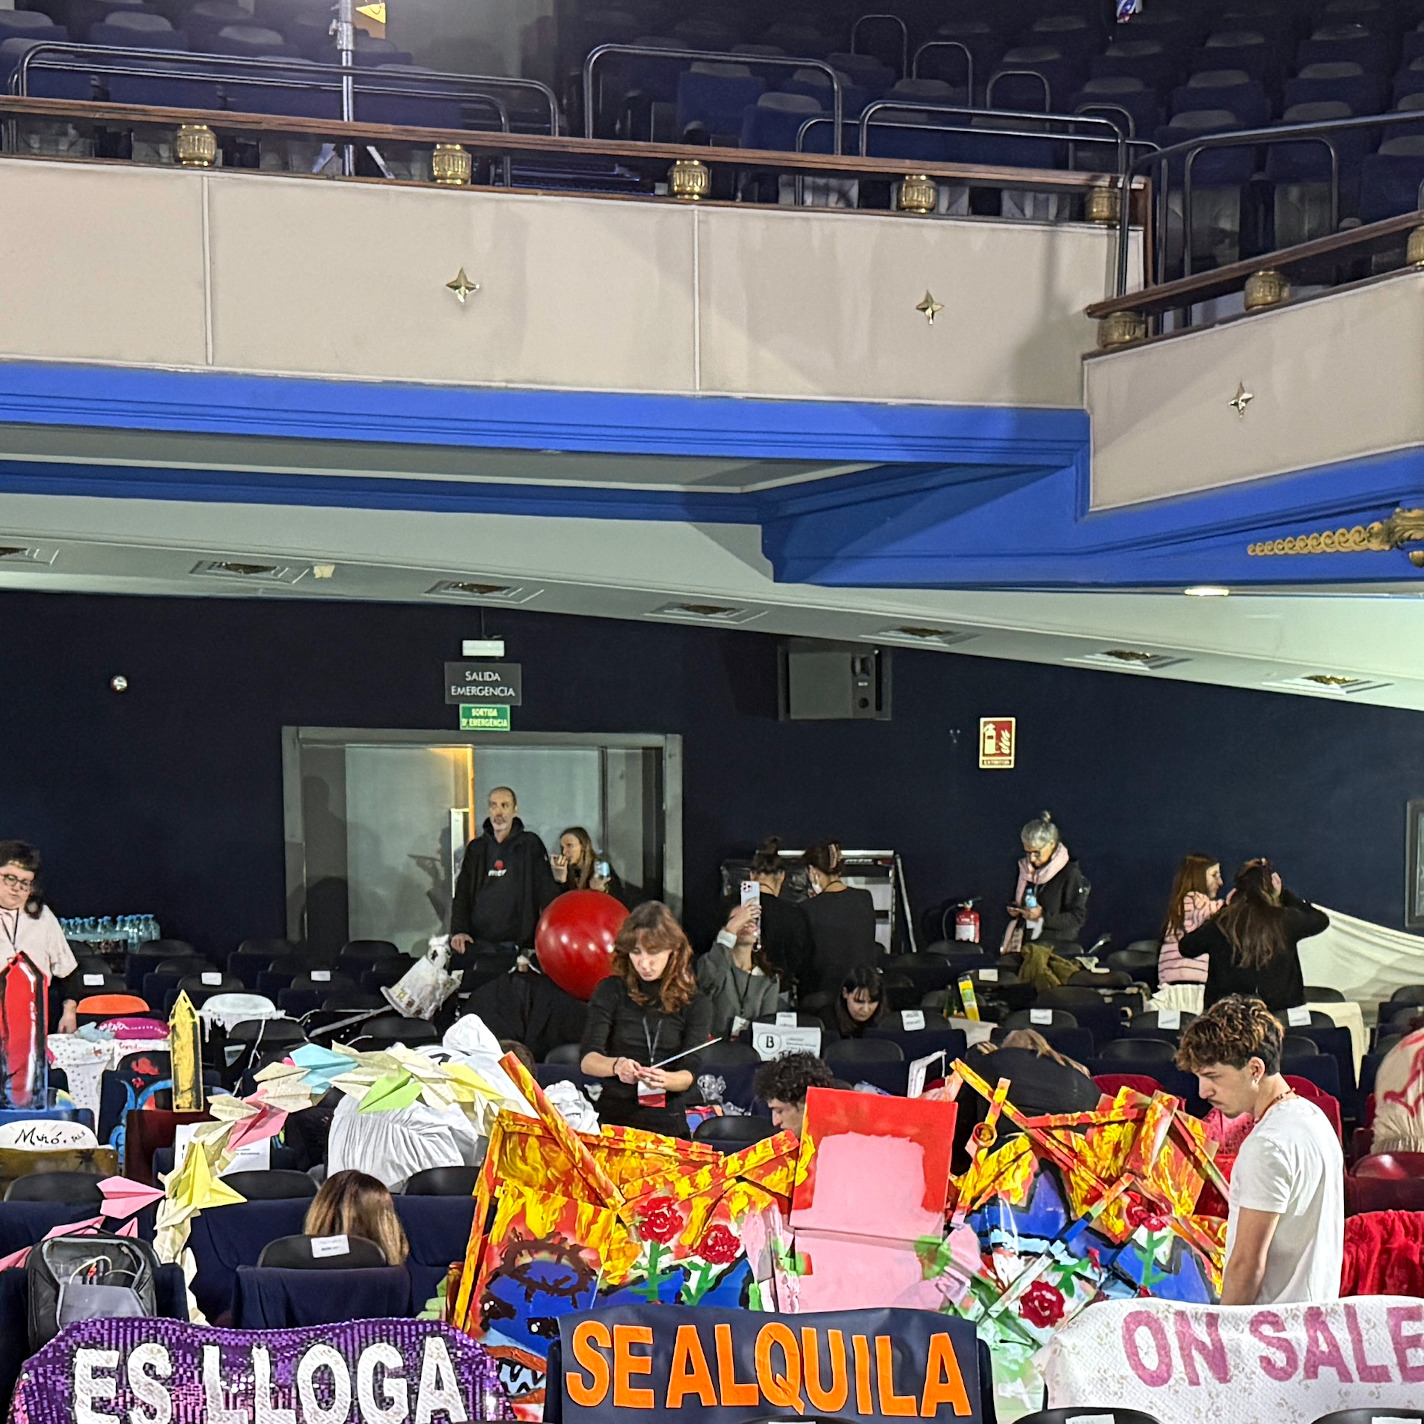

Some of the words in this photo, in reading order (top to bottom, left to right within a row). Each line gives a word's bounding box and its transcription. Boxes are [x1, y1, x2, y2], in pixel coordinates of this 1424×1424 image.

[451, 685, 515, 696] EMERGENCIA
[465, 671, 501, 681] SALIDA
[566, 1320, 655, 1409] SE
[666, 1322, 973, 1418] ALQUILA
[1122, 1309, 1232, 1387] ON
